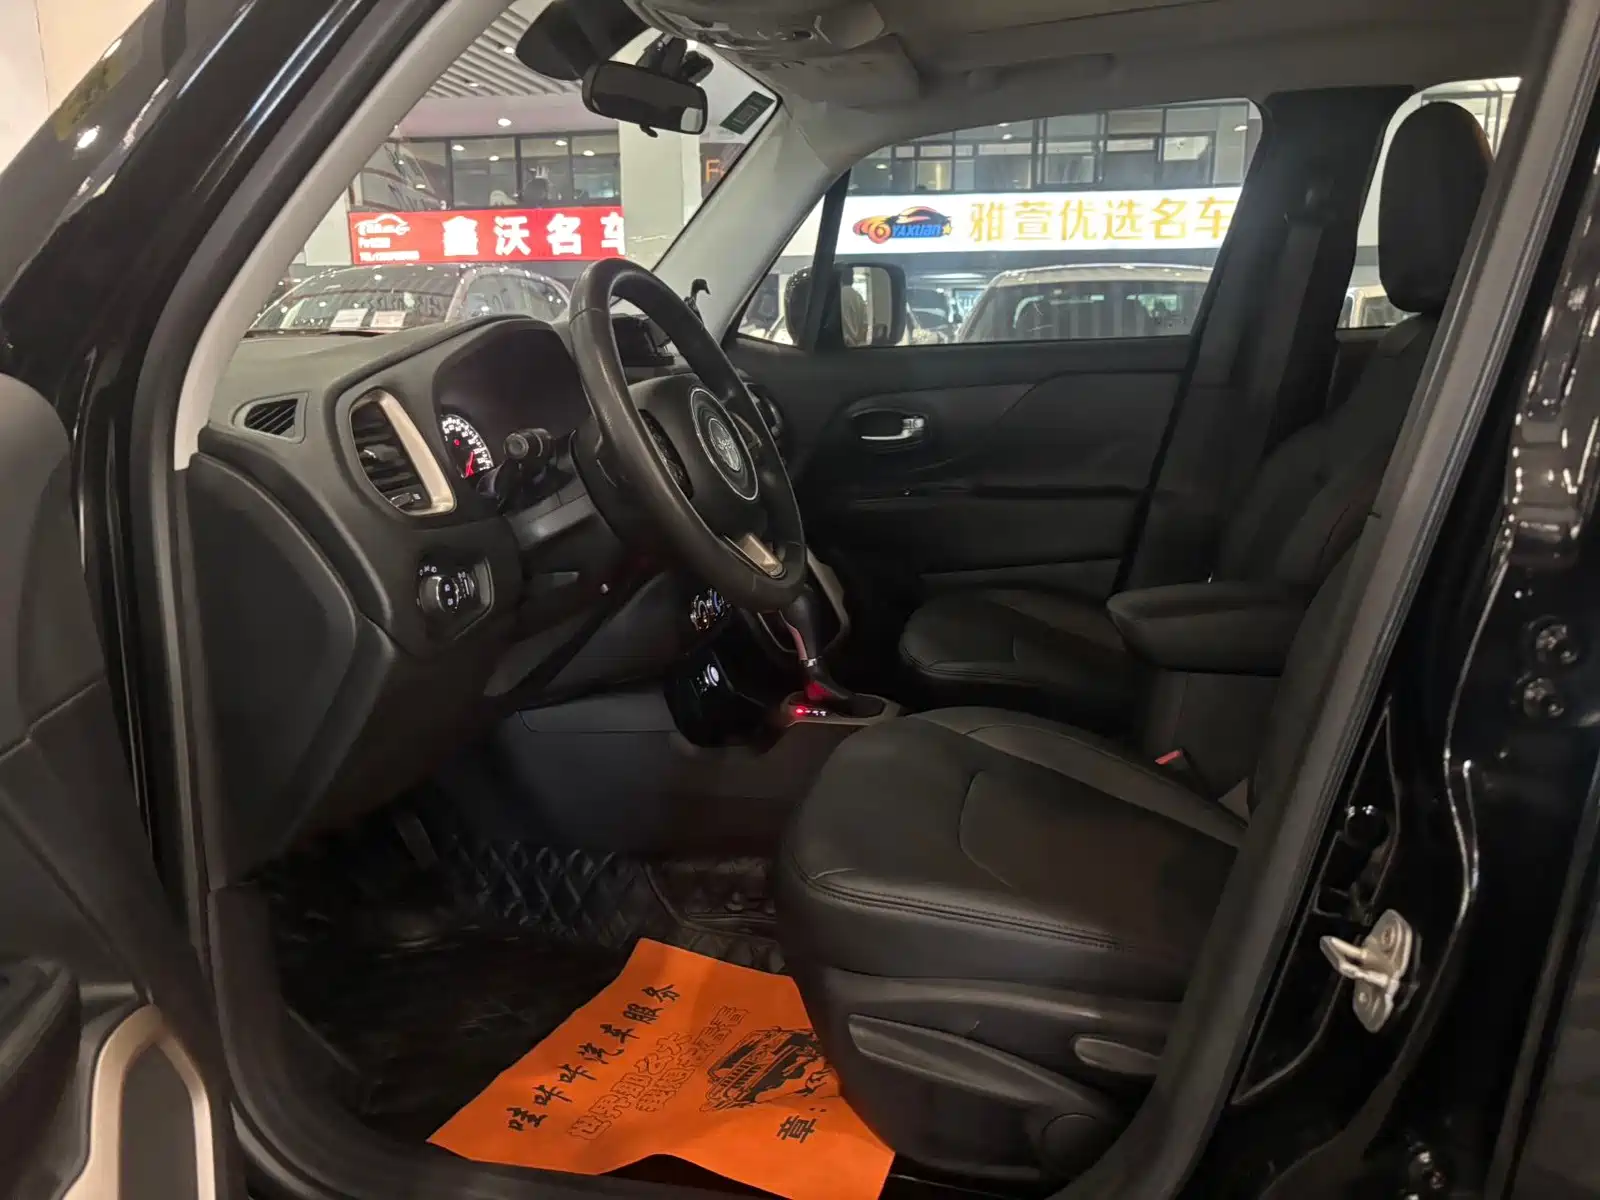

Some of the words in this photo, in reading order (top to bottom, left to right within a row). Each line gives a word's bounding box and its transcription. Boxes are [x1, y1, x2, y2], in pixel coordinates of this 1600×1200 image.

[969, 196, 1236, 243] 雅萱优选名车
[567, 1032, 695, 1141] 世界那么大
